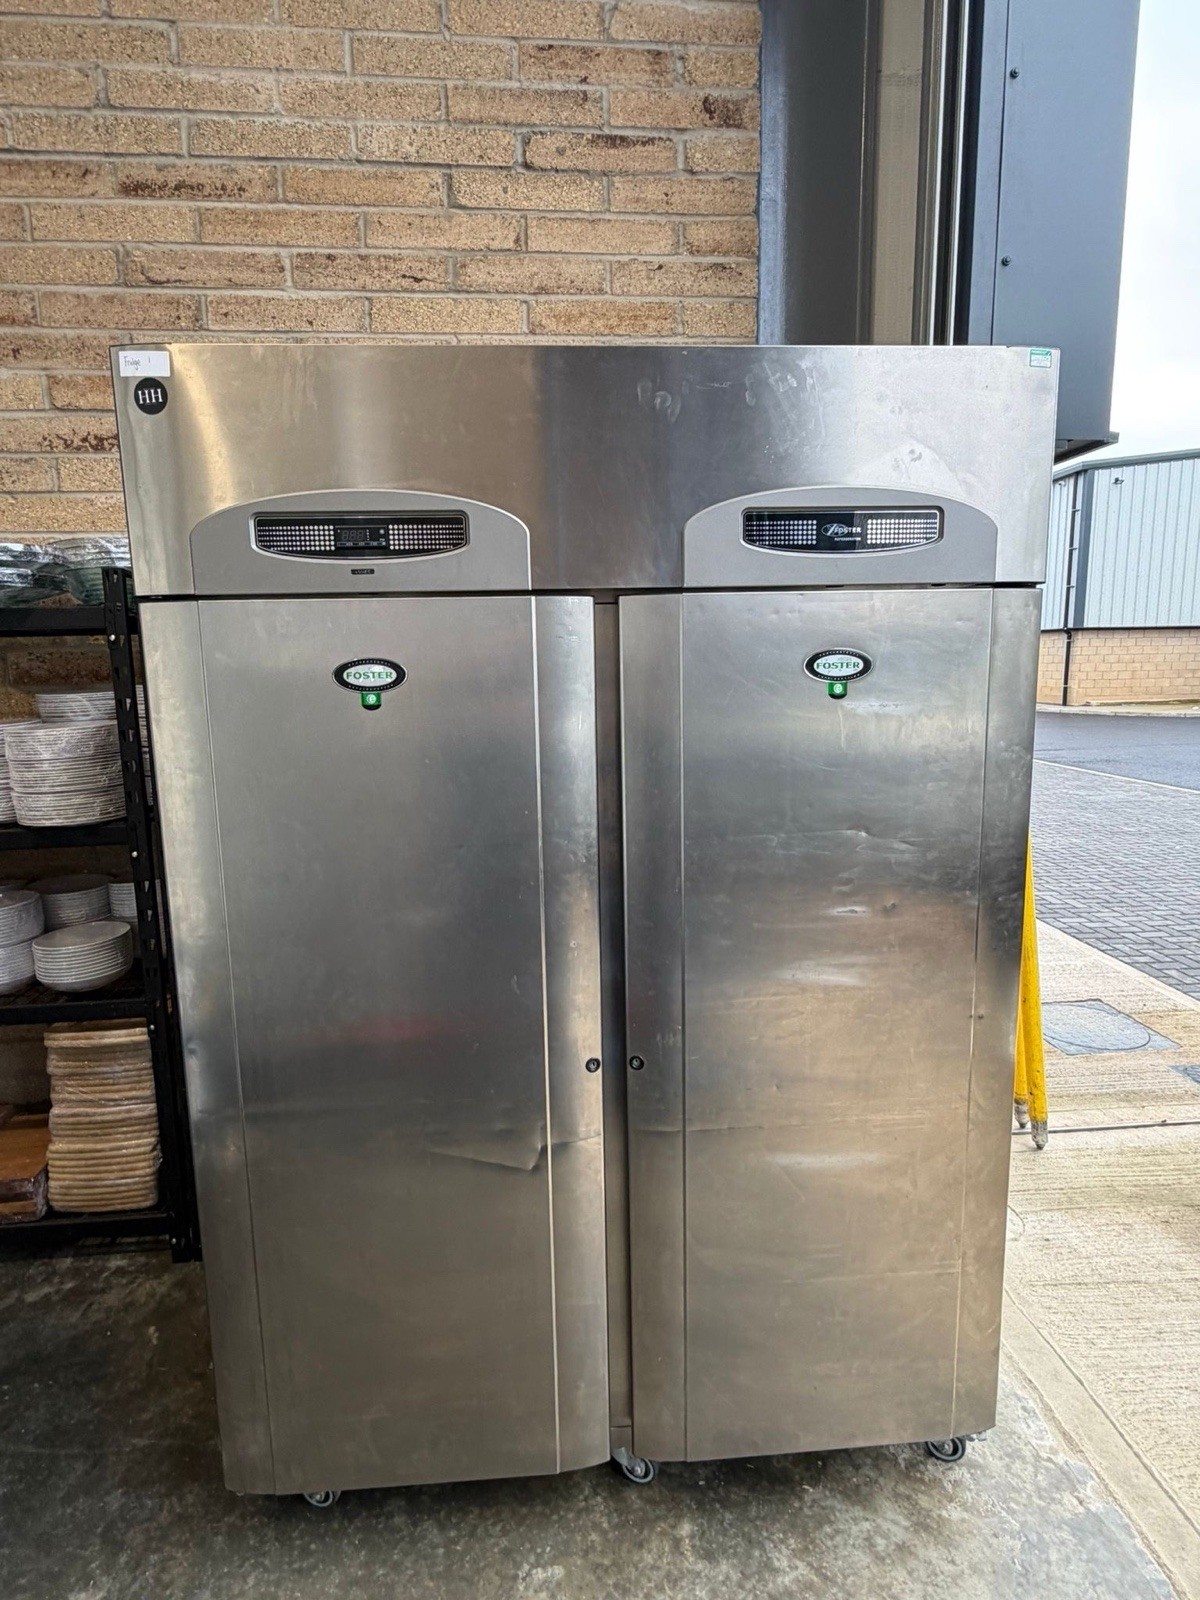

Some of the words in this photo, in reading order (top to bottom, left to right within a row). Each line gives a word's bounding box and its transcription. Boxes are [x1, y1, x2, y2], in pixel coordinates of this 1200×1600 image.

[137, 388, 163, 405] HH
[815, 661, 861, 670] FOSTER
[345, 671, 394, 680] FOSTER
